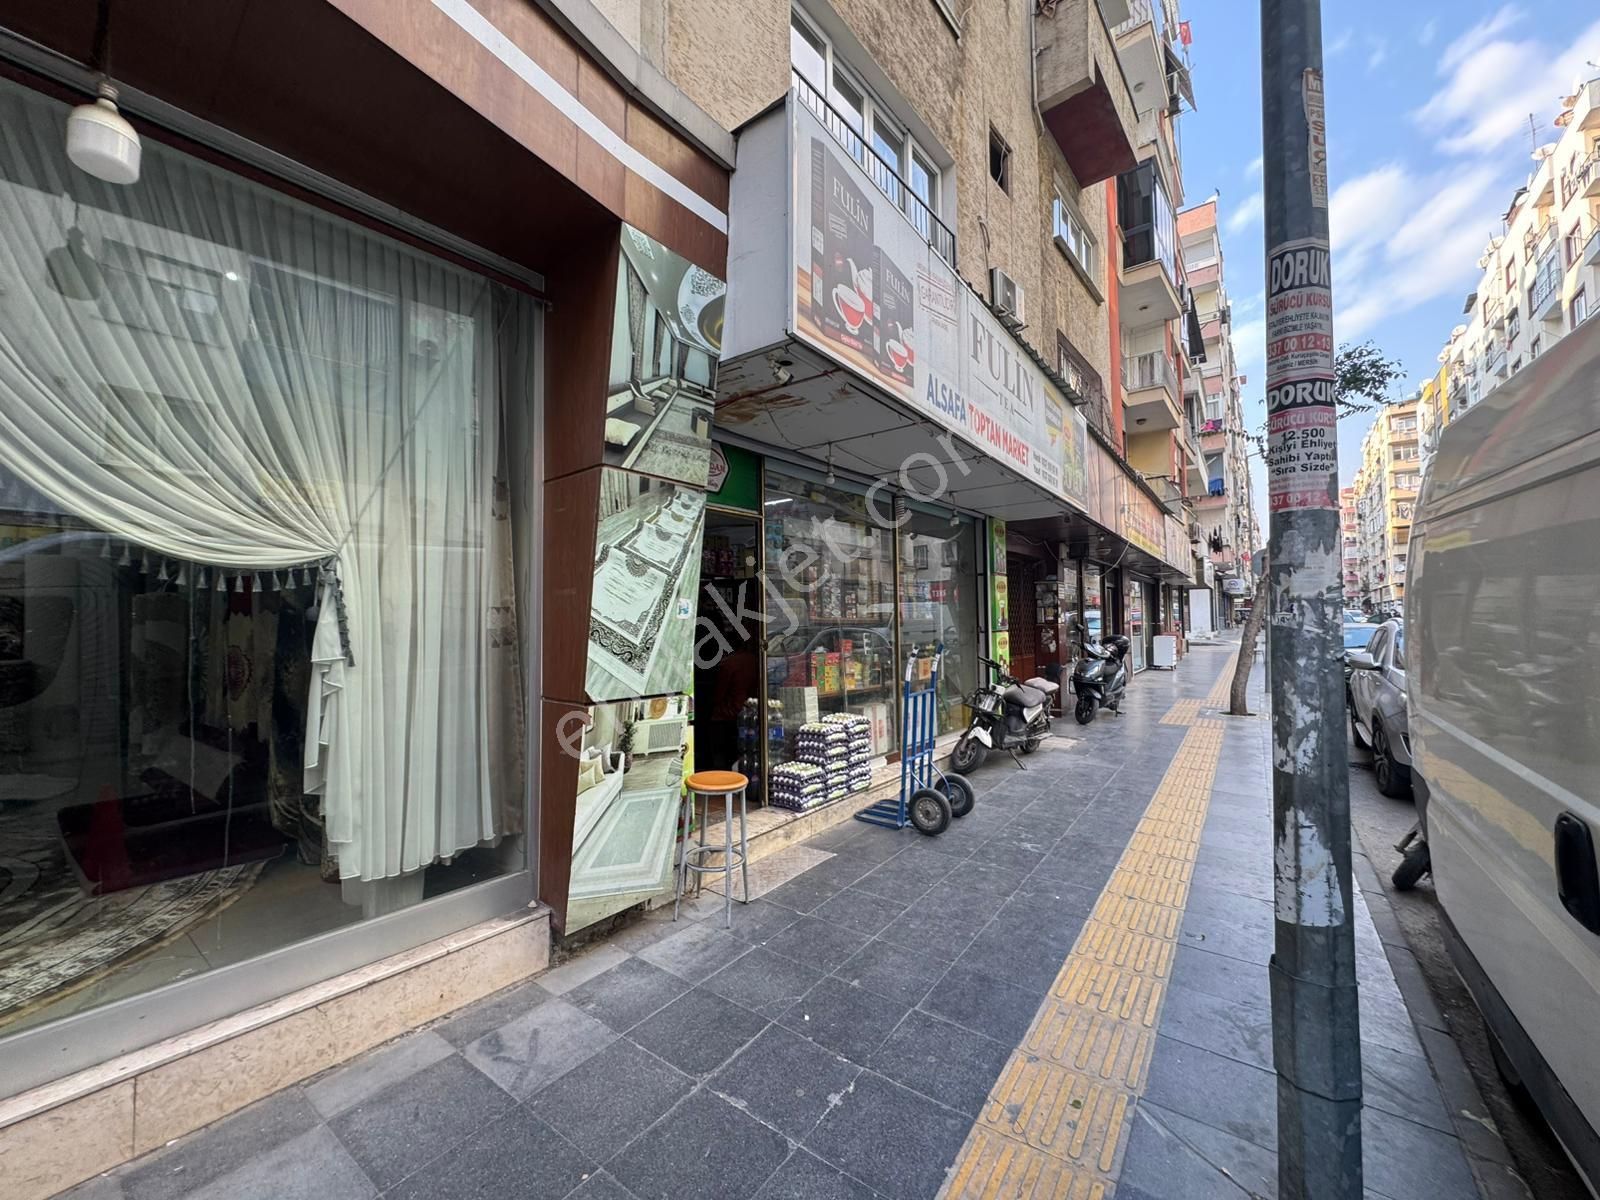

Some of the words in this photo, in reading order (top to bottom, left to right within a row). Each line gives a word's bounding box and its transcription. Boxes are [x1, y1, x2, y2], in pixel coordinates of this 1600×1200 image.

[1271, 250, 1330, 294] DORUK
[1269, 292, 1303, 317] SÜRÜCÜ
[1306, 292, 1331, 309] KURSU
[1284, 337, 1298, 351] 00
[1302, 335, 1315, 349] 12
[970, 312, 1035, 413] FULİN
[998, 391, 1015, 415] TEA
[1268, 381, 1336, 410] DORUK
[926, 373, 967, 426] ALSAFA
[968, 402, 1001, 450] TOPTAN
[1001, 428, 1030, 467] MARKET
[1268, 440, 1297, 455] Kişiyi
[1301, 438, 1337, 450] Ehliyet
[1281, 428, 1325, 441] 12.500
[1268, 452, 1300, 467] Sahibi
